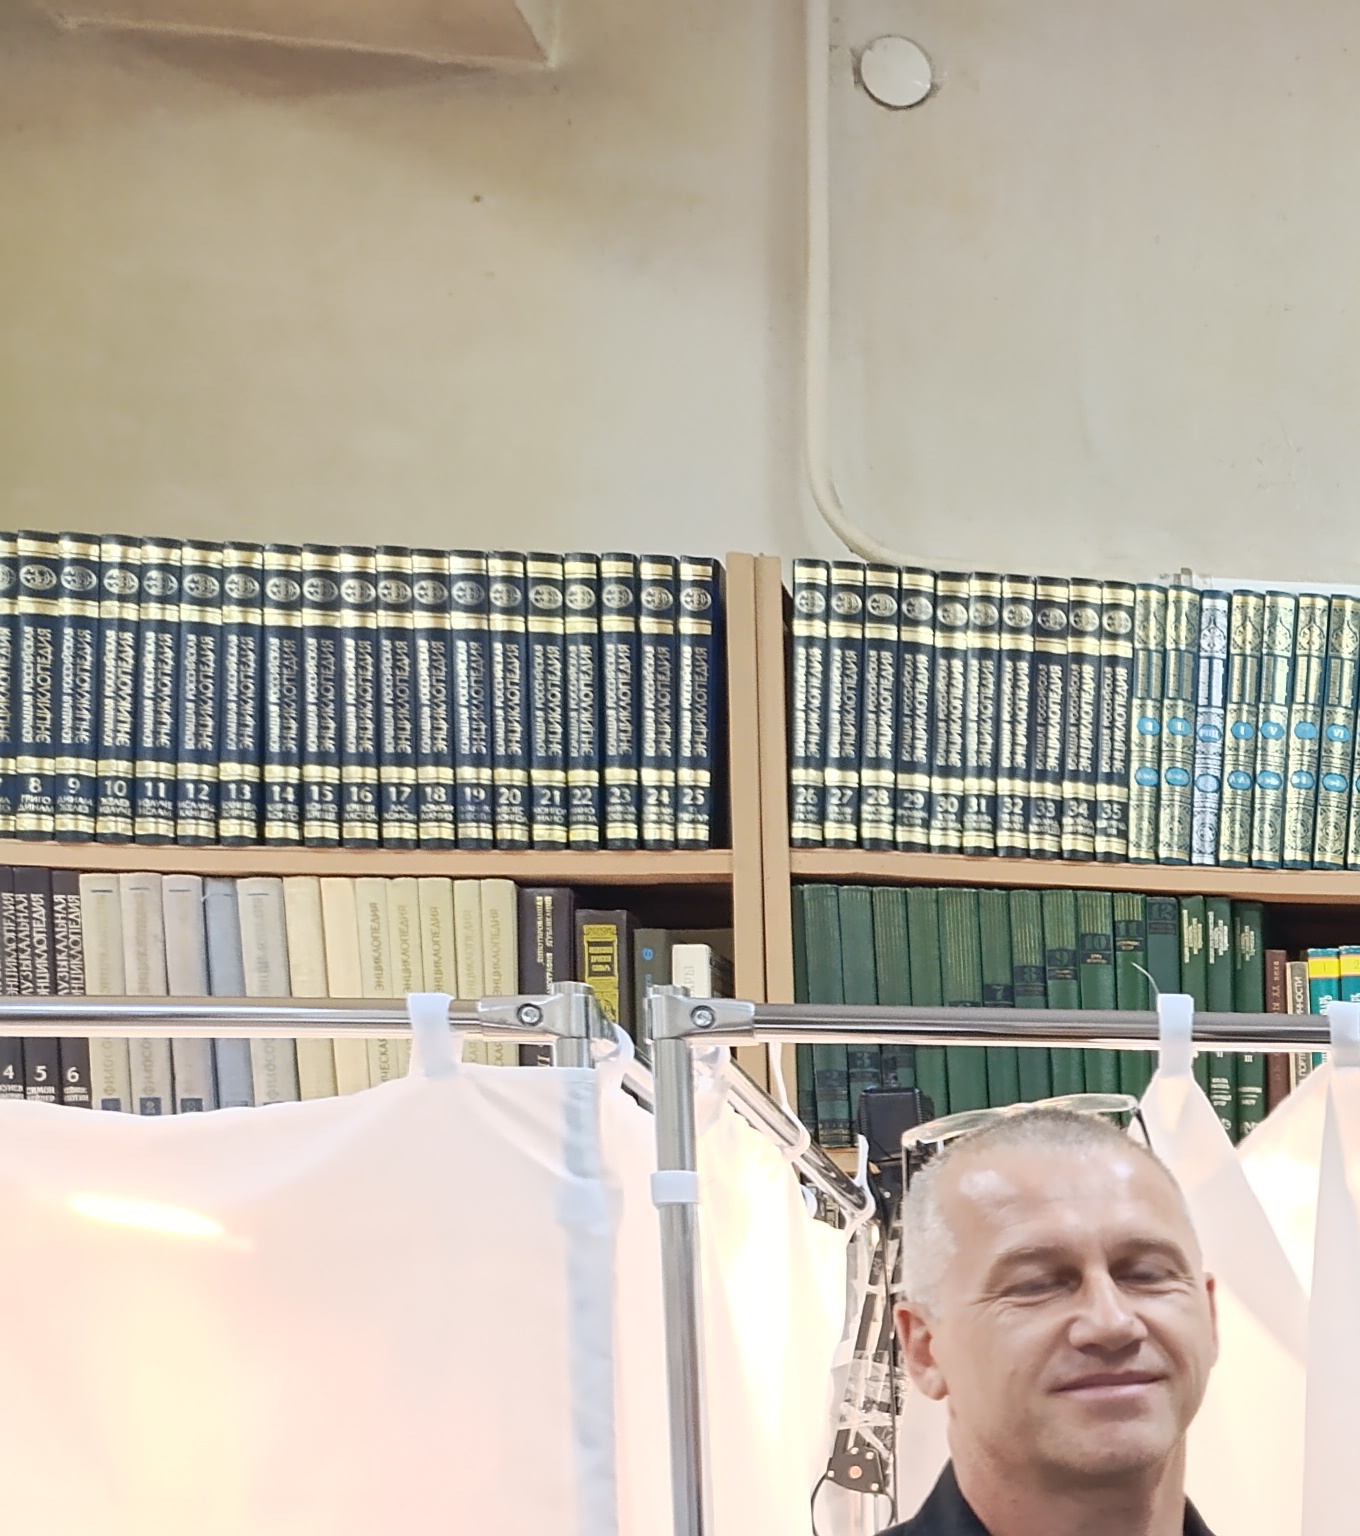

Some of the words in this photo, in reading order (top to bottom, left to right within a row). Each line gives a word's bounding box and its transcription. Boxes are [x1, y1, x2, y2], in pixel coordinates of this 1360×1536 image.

[36, 629, 53, 743] ЭНЦИКЛОПЕДИЯ
[199, 637, 214, 750] ЭНЦИКЛОПЕДИЯ
[506, 645, 521, 754] ЭНЦИКЛОПЕДИЯ
[878, 652, 893, 758] ЭНЦИКЛОПЕДИЯ
[29, 777, 42, 792] 8
[105, 780, 126, 797] 10
[145, 782, 166, 797] 11
[186, 783, 210, 799] 12
[272, 786, 295, 801] 14
[425, 787, 446, 802] 18
[500, 789, 522, 804] 20
[798, 788, 818, 803] 26
[868, 790, 890, 804] 28
[1002, 799, 1023, 816] 32
[370, 902, 384, 991] ЭНЦИКЛОПЕДИЯ
[35, 1065, 47, 1081] 5
[67, 1067, 79, 1082] 6
